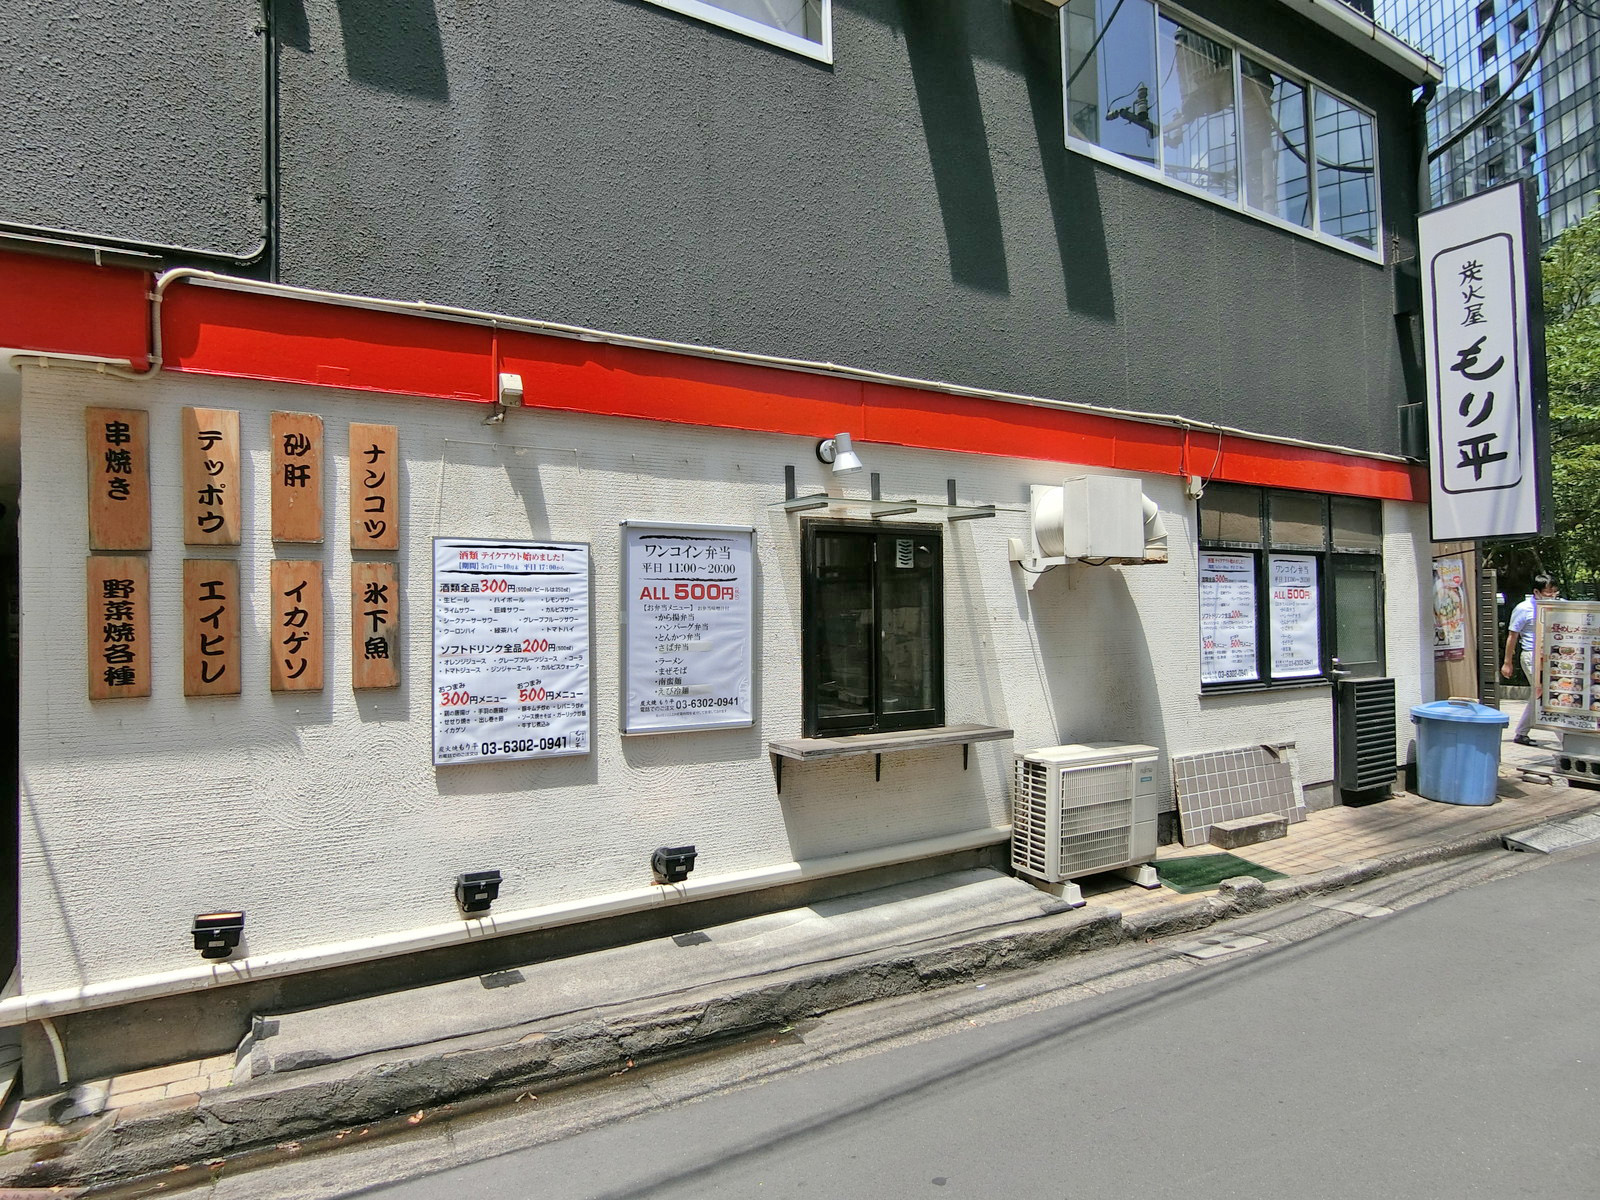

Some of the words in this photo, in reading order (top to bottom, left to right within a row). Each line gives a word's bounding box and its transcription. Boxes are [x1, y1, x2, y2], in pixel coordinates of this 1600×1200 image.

[1450, 335, 1508, 481] もり平
[105, 421, 132, 500] 串焼き
[283, 433, 311, 488] 砂肝
[198, 430, 226, 533] テッポウ
[364, 444, 386, 539] ナンコツ
[459, 551, 478, 560] 酒類
[645, 545, 731, 560] ワンコイン弁当
[642, 563, 662, 573] 平日
[640, 587, 670, 600] ALL
[674, 584, 734, 600] 500円
[364, 582, 389, 660] 氷下魚
[658, 623, 709, 631] ハンバーグ弁当
[103, 579, 135, 687] 野菜焼各種
[198, 580, 226, 683] エイヒレ
[283, 581, 310, 679] イカゲソ
[658, 633, 701, 641] とんかつ弁当
[658, 666, 687, 675] まぜそば
[439, 683, 466, 693] おつまみ
[517, 679, 542, 689] おつまみ
[440, 691, 507, 706] 300円メニュー
[520, 687, 583, 701] 500円メニュー
[676, 697, 739, 709] 03-6302-0941
[482, 736, 566, 755] 03-6302-0941
